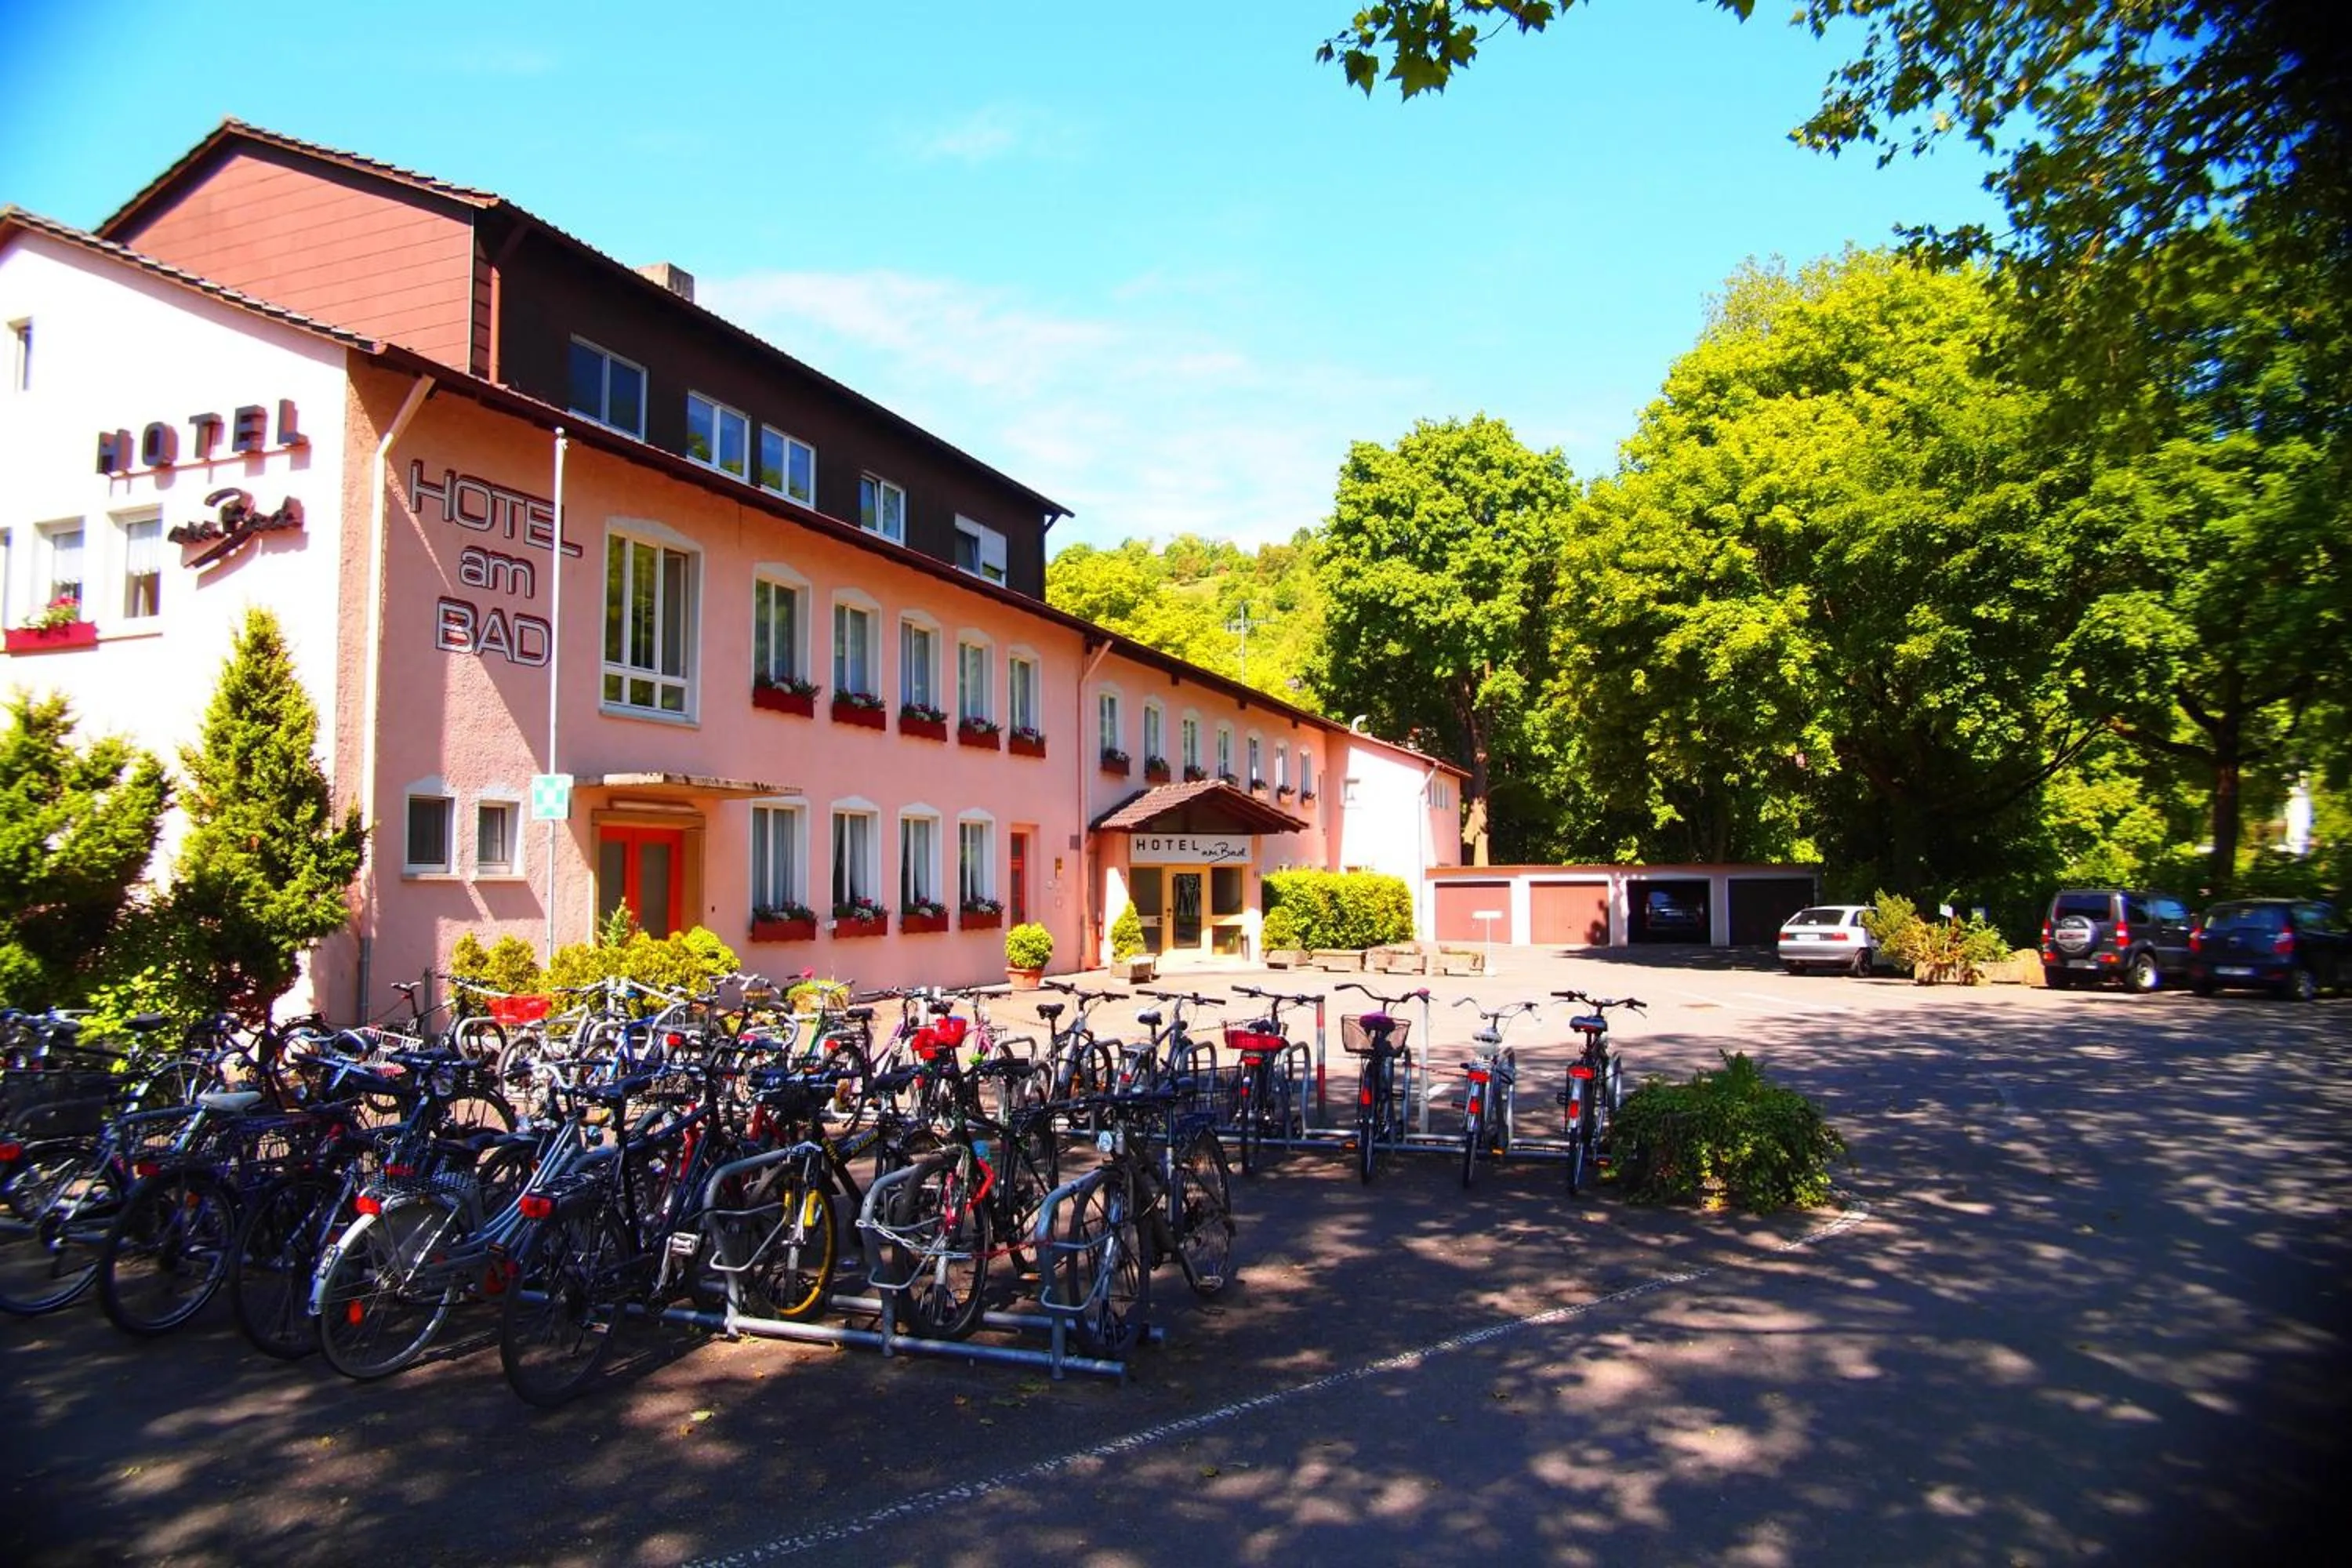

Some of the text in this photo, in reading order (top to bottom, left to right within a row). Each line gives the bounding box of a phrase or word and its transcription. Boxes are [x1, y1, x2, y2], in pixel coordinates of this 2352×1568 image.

[96, 397, 311, 475] HOTEL
[408, 458, 583, 559] HOTEL
[459, 545, 535, 600] am
[435, 595, 553, 667] BAD
[1136, 839, 1200, 851] HOTEL
[1210, 840, 1247, 863] Bad
